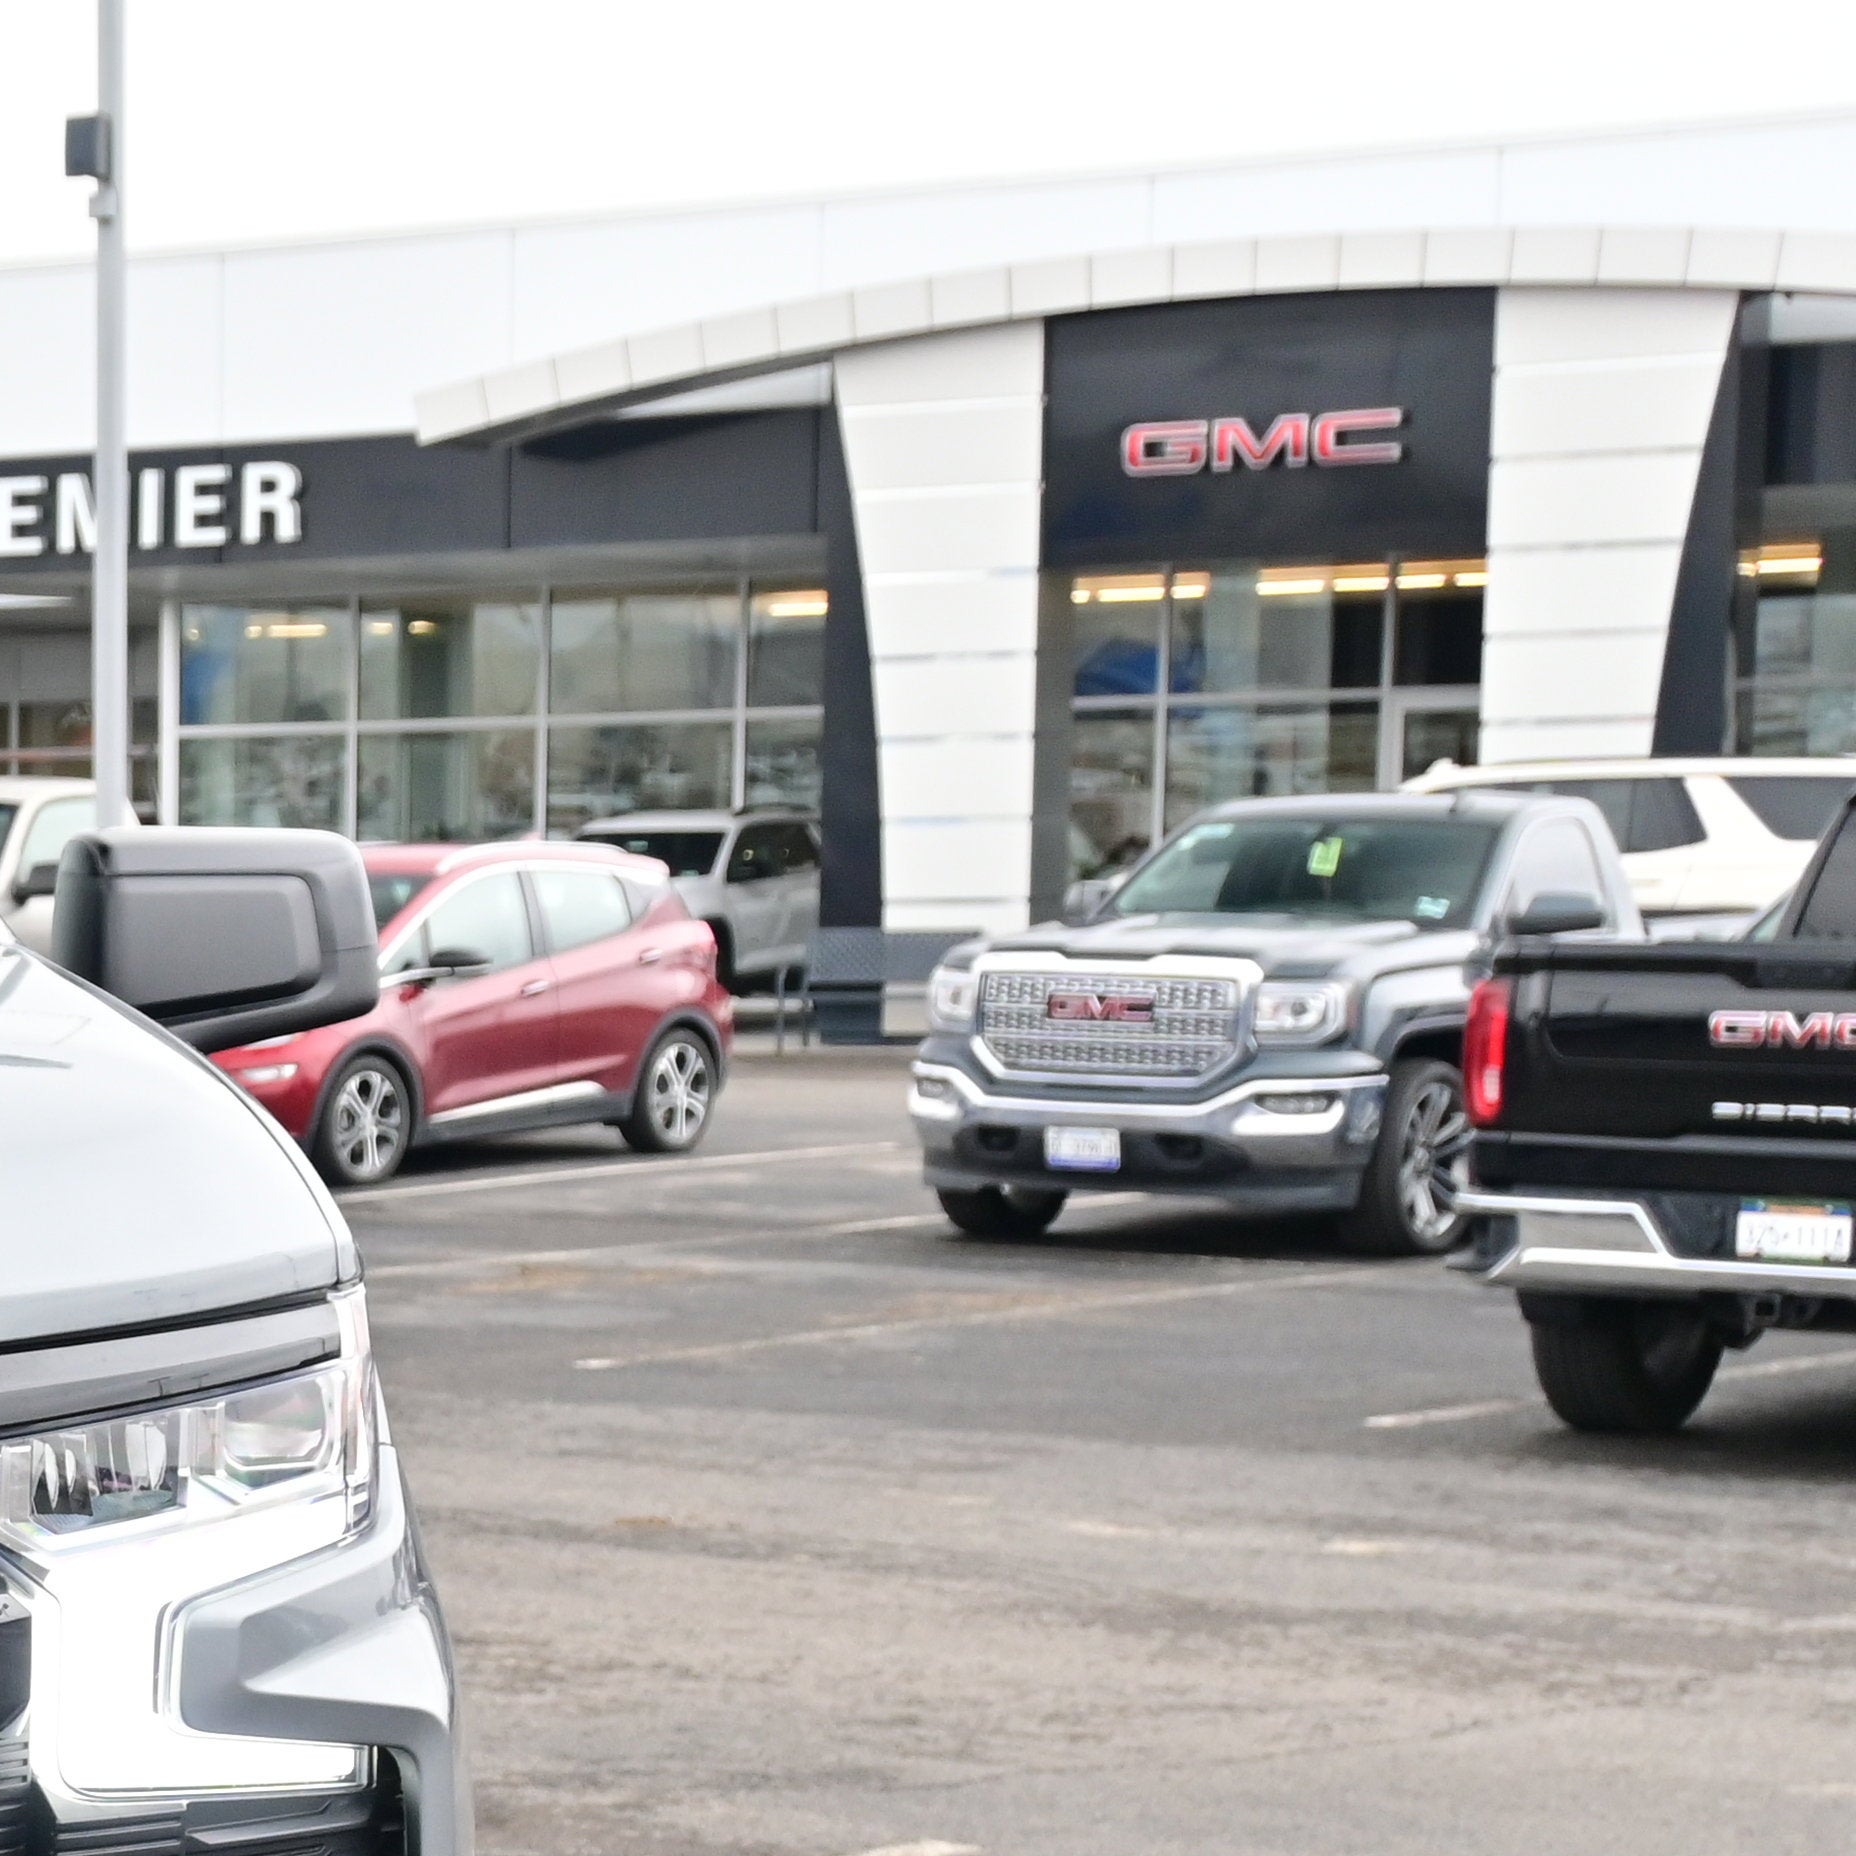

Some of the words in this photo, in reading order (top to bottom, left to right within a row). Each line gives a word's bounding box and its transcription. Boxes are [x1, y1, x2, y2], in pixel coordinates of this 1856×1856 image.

[1120, 407, 1404, 478] GMC
[1047, 993, 1154, 1022] GMC
[1712, 1101, 1856, 1126] SIERR
